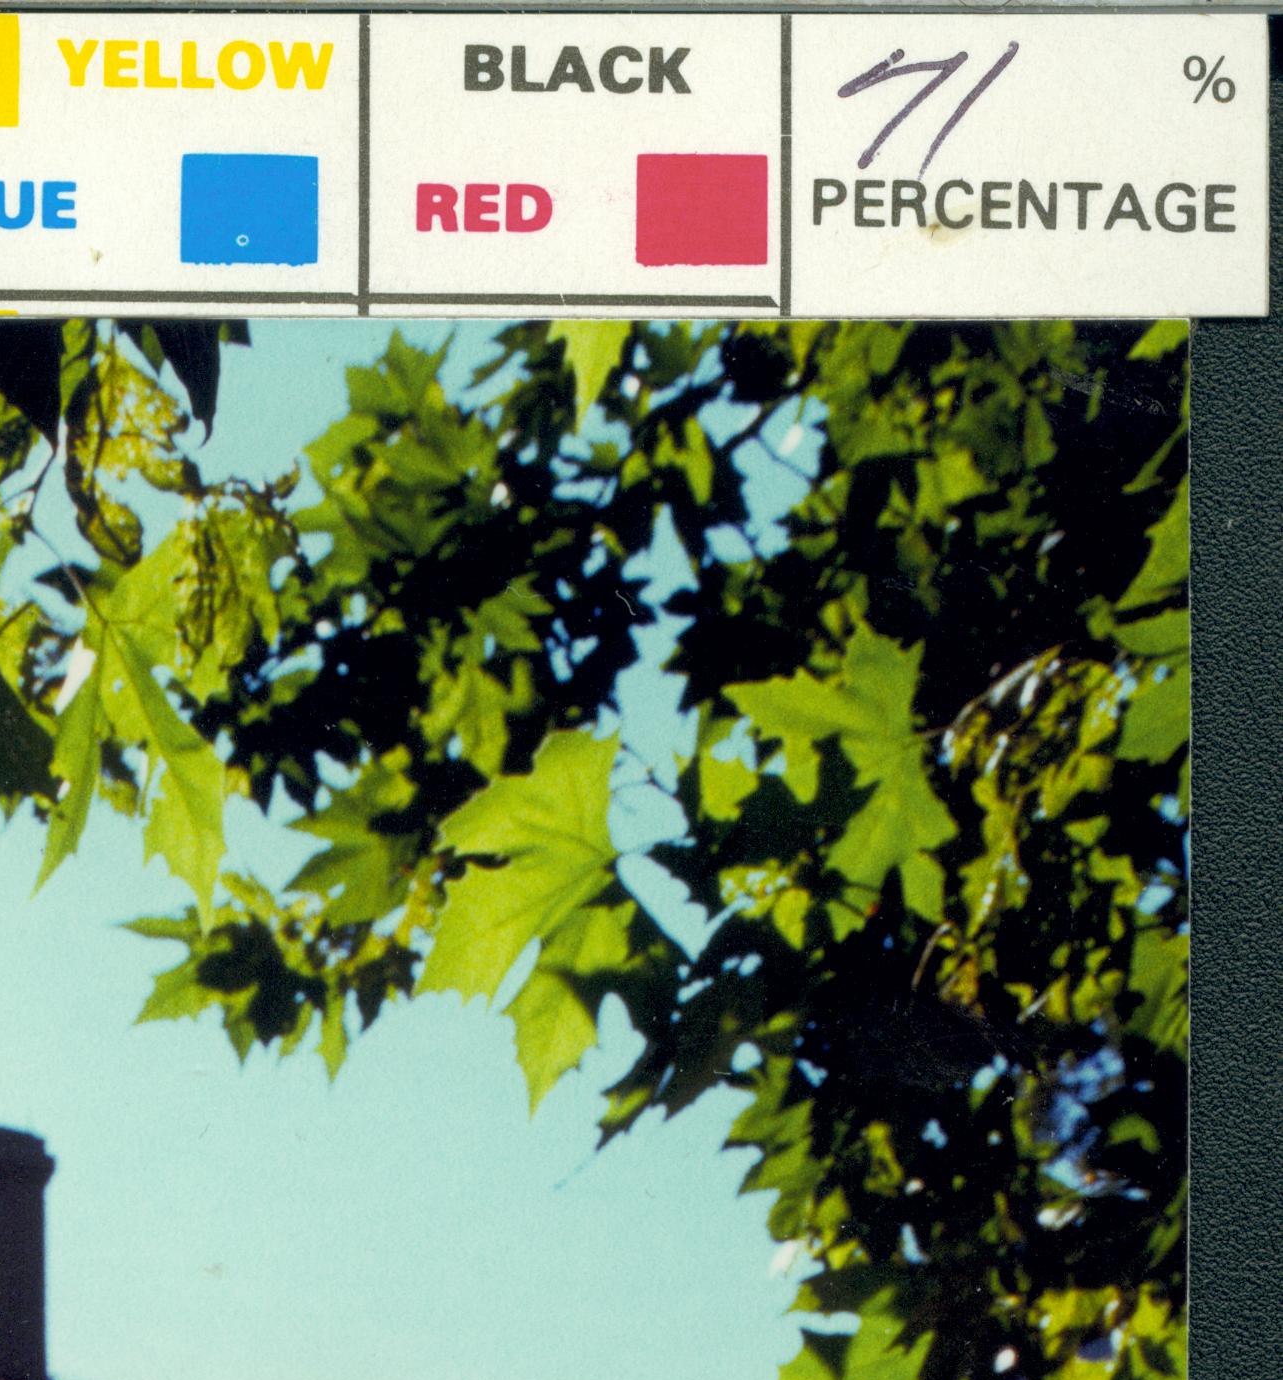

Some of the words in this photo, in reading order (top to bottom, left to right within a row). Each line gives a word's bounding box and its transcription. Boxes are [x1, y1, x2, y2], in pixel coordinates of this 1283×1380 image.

[58, 39, 335, 90] YELLOW
[464, 44, 692, 94] BLACK
[1183, 55, 1237, 104] %
[416, 183, 554, 233] RED
[812, 178, 1238, 234] PERCENTAGE
